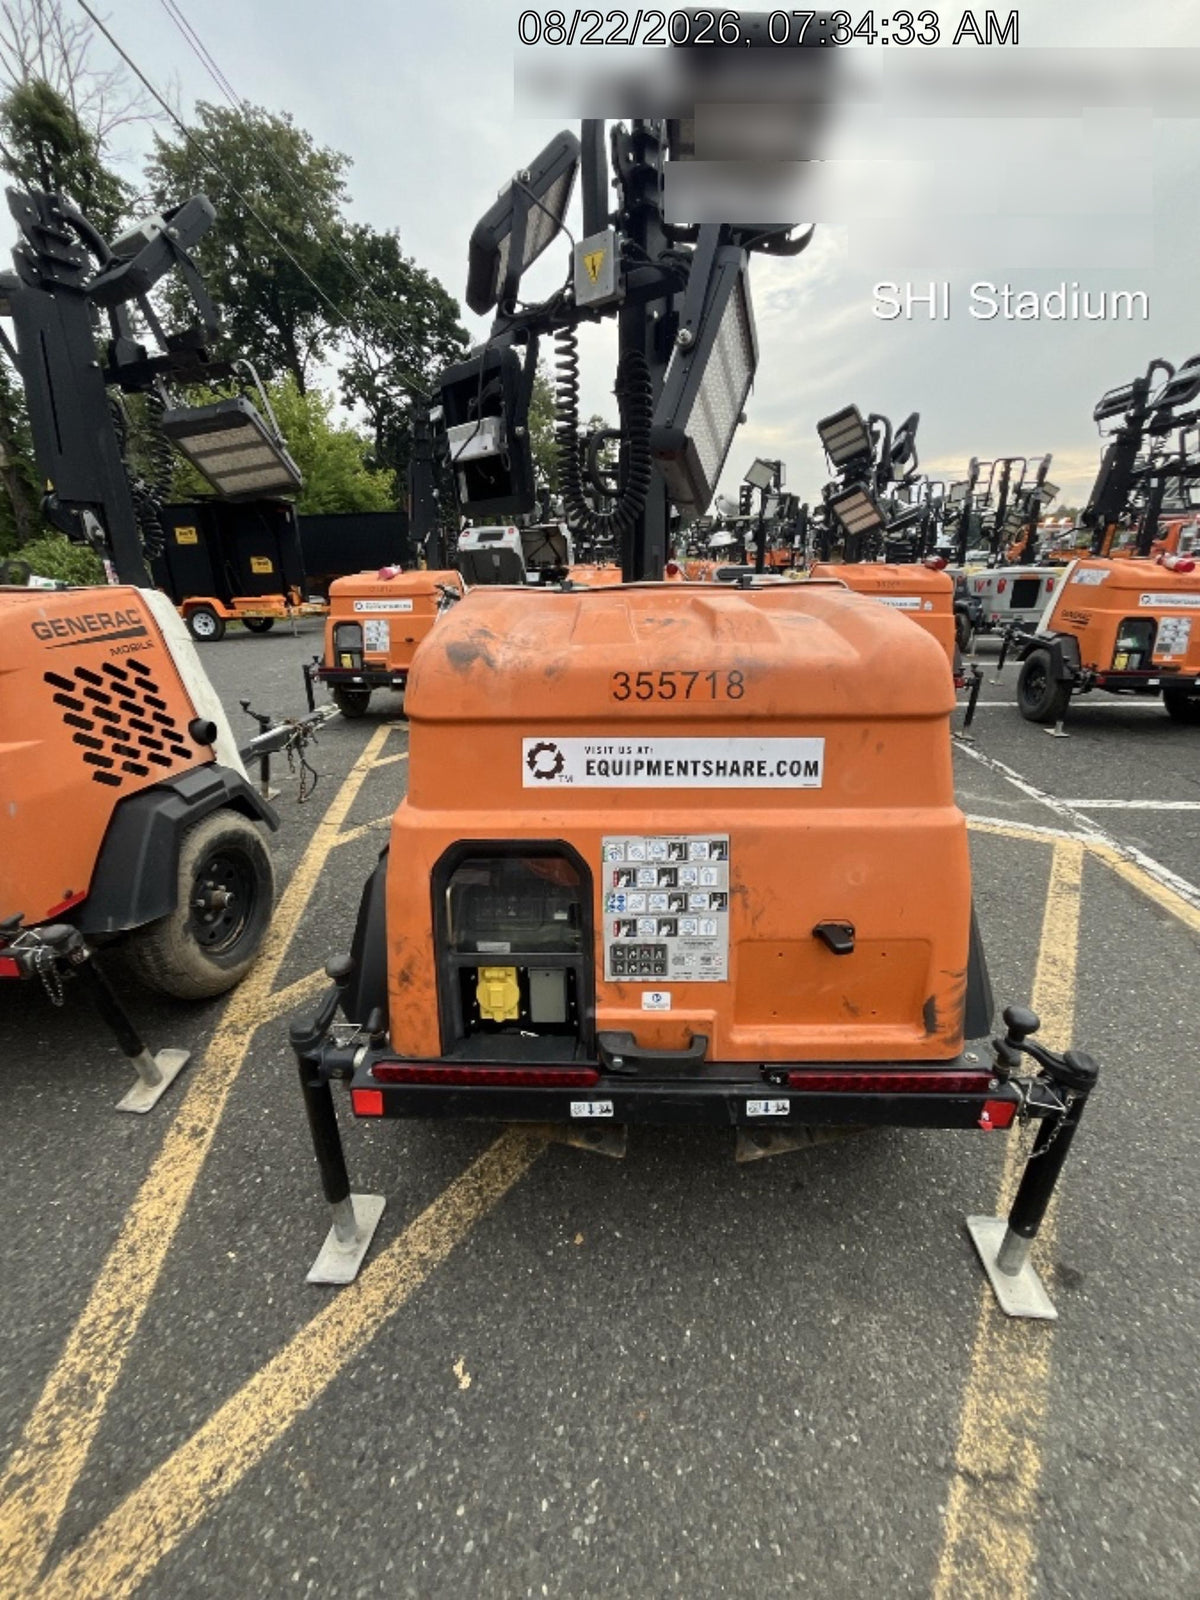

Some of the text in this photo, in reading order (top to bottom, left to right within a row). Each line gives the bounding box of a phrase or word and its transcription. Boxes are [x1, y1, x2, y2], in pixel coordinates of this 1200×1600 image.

[31, 609, 141, 640] GENERAC
[110, 640, 154, 656] MOBILE
[613, 670, 745, 701] 355718
[585, 745, 654, 755] VISIT US AT:
[585, 758, 819, 778] EQUIPMENTSHARE.COM
[558, 774, 574, 784] TM
